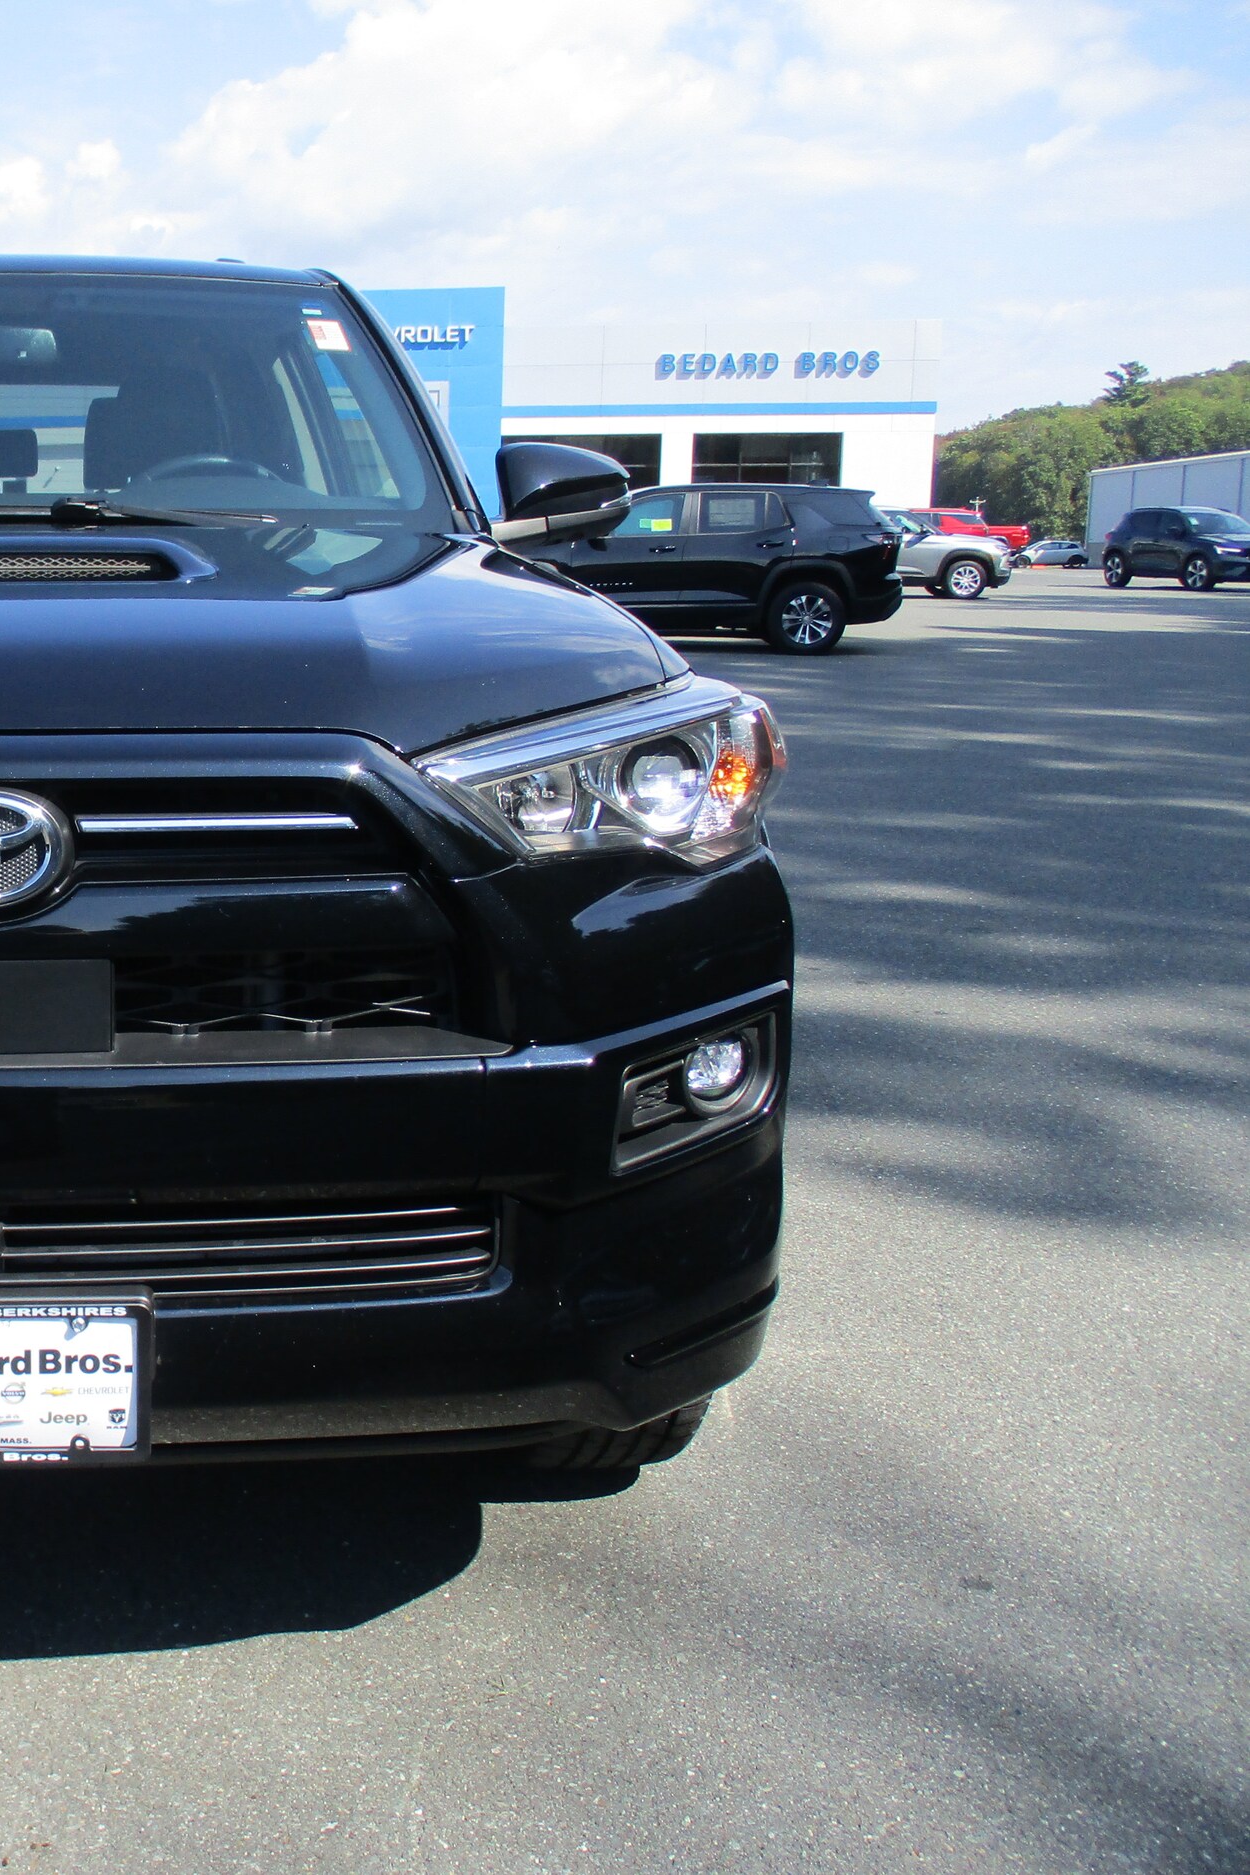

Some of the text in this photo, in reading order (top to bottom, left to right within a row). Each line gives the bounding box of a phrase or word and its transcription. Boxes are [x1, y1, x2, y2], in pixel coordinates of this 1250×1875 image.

[659, 350, 880, 376] BEDARD BROS
[38, 1348, 133, 1374] Bros.
[77, 1386, 130, 1395] CHEVROLET
[39, 1411, 88, 1425] Jeep
[3, 1452, 69, 1461] Bros.
